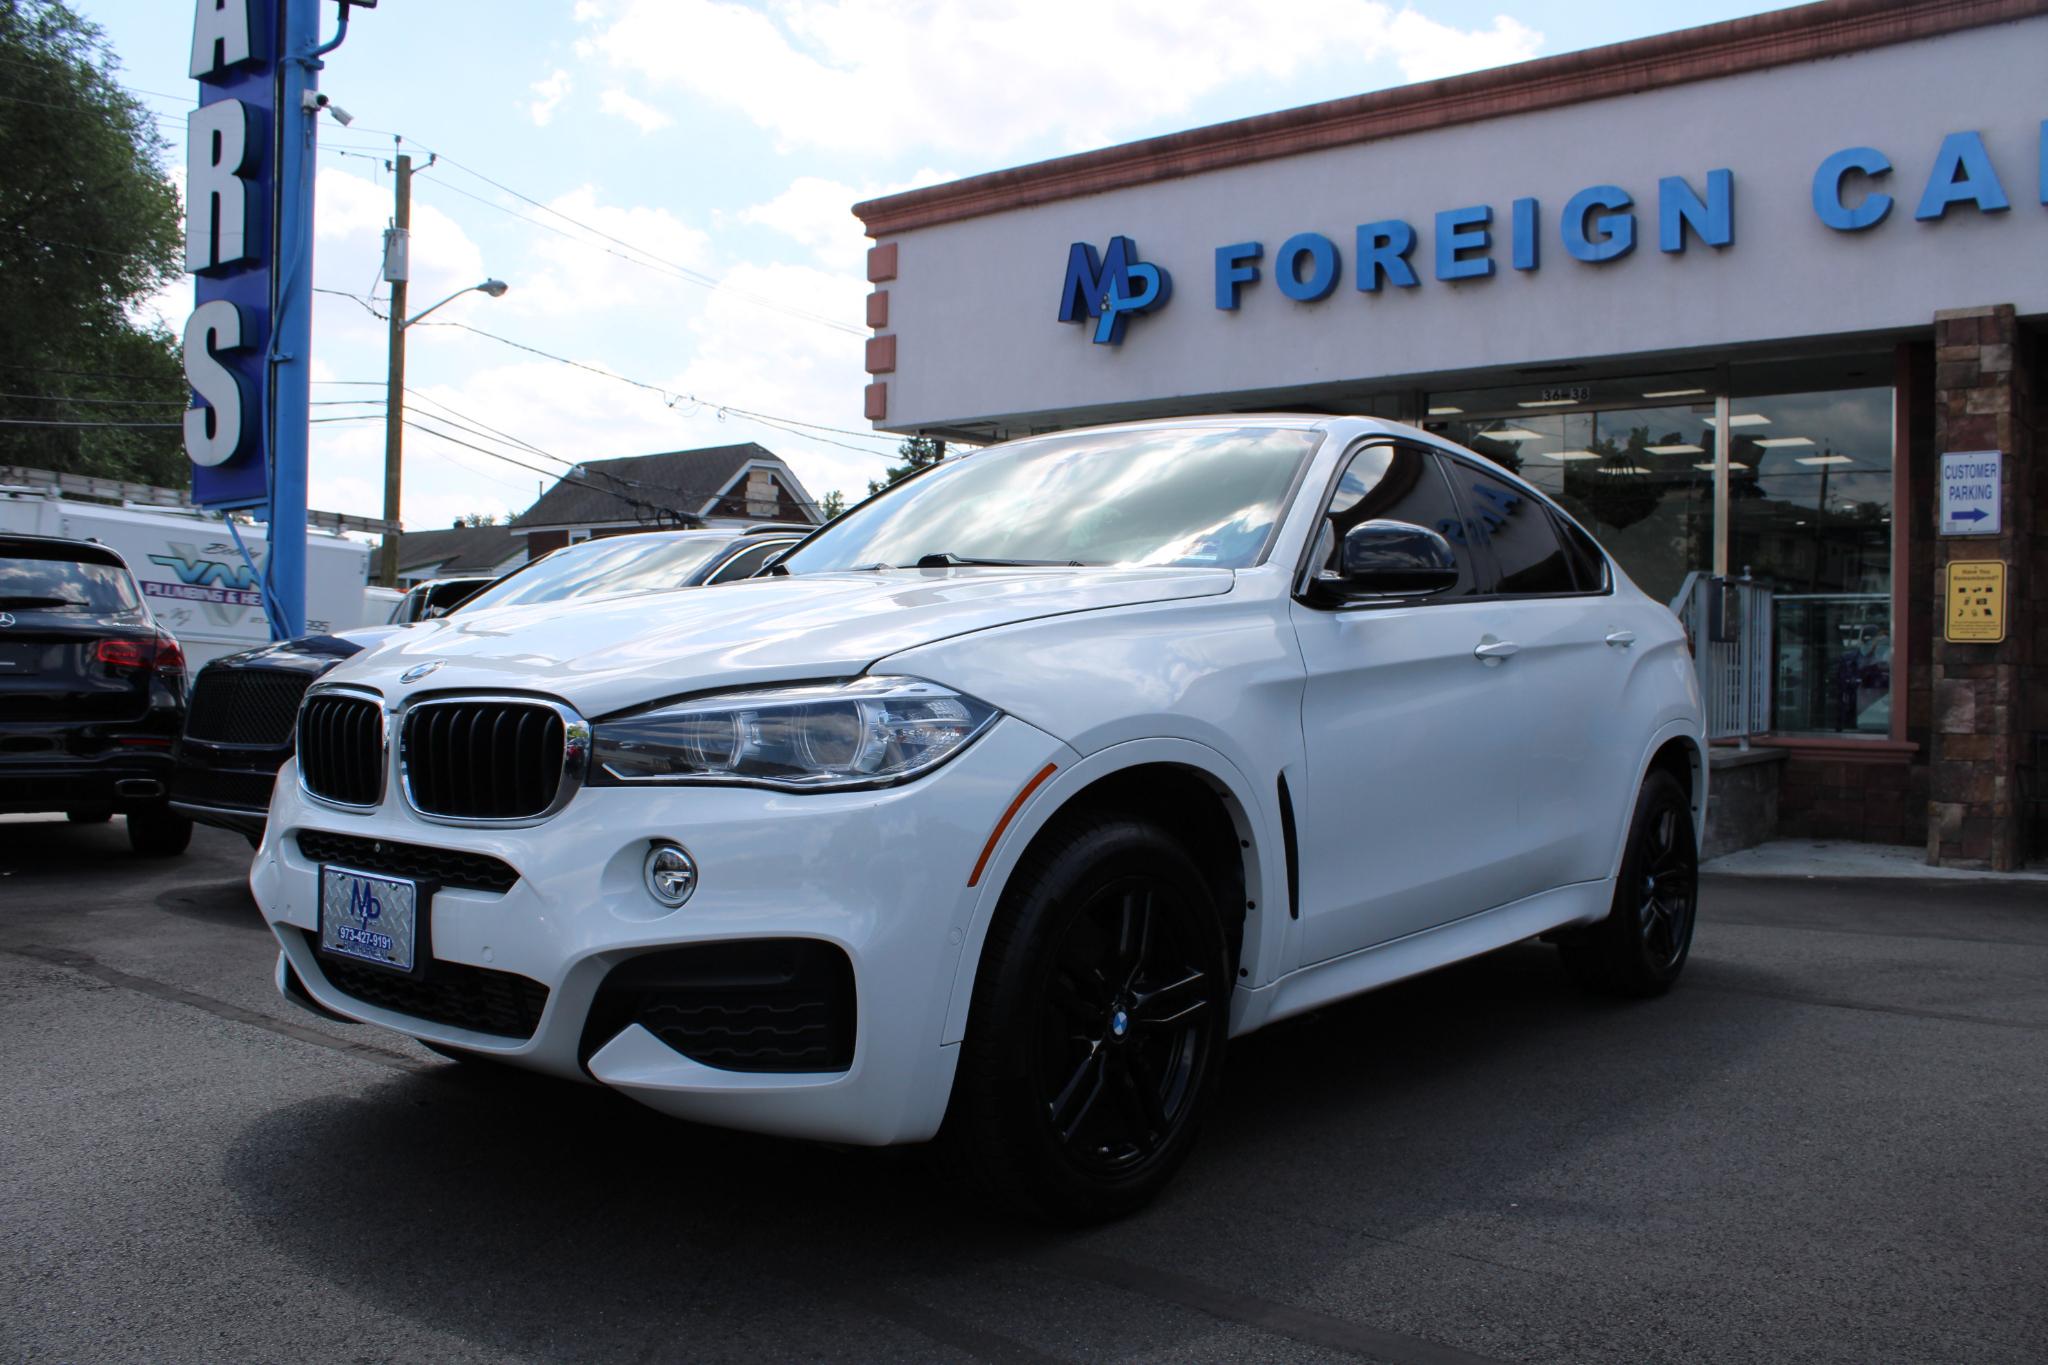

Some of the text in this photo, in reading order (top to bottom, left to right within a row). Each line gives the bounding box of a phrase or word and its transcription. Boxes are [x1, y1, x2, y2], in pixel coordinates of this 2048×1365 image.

[1215, 168, 1735, 310] FOREIGN
[1812, 119, 2048, 232] CA
[1944, 463, 1997, 480] CUSTOMER
[1949, 484, 1992, 500] PARKING
[144, 584, 225, 602] PLUMBING
[340, 927, 391, 950] 973-427-9191
